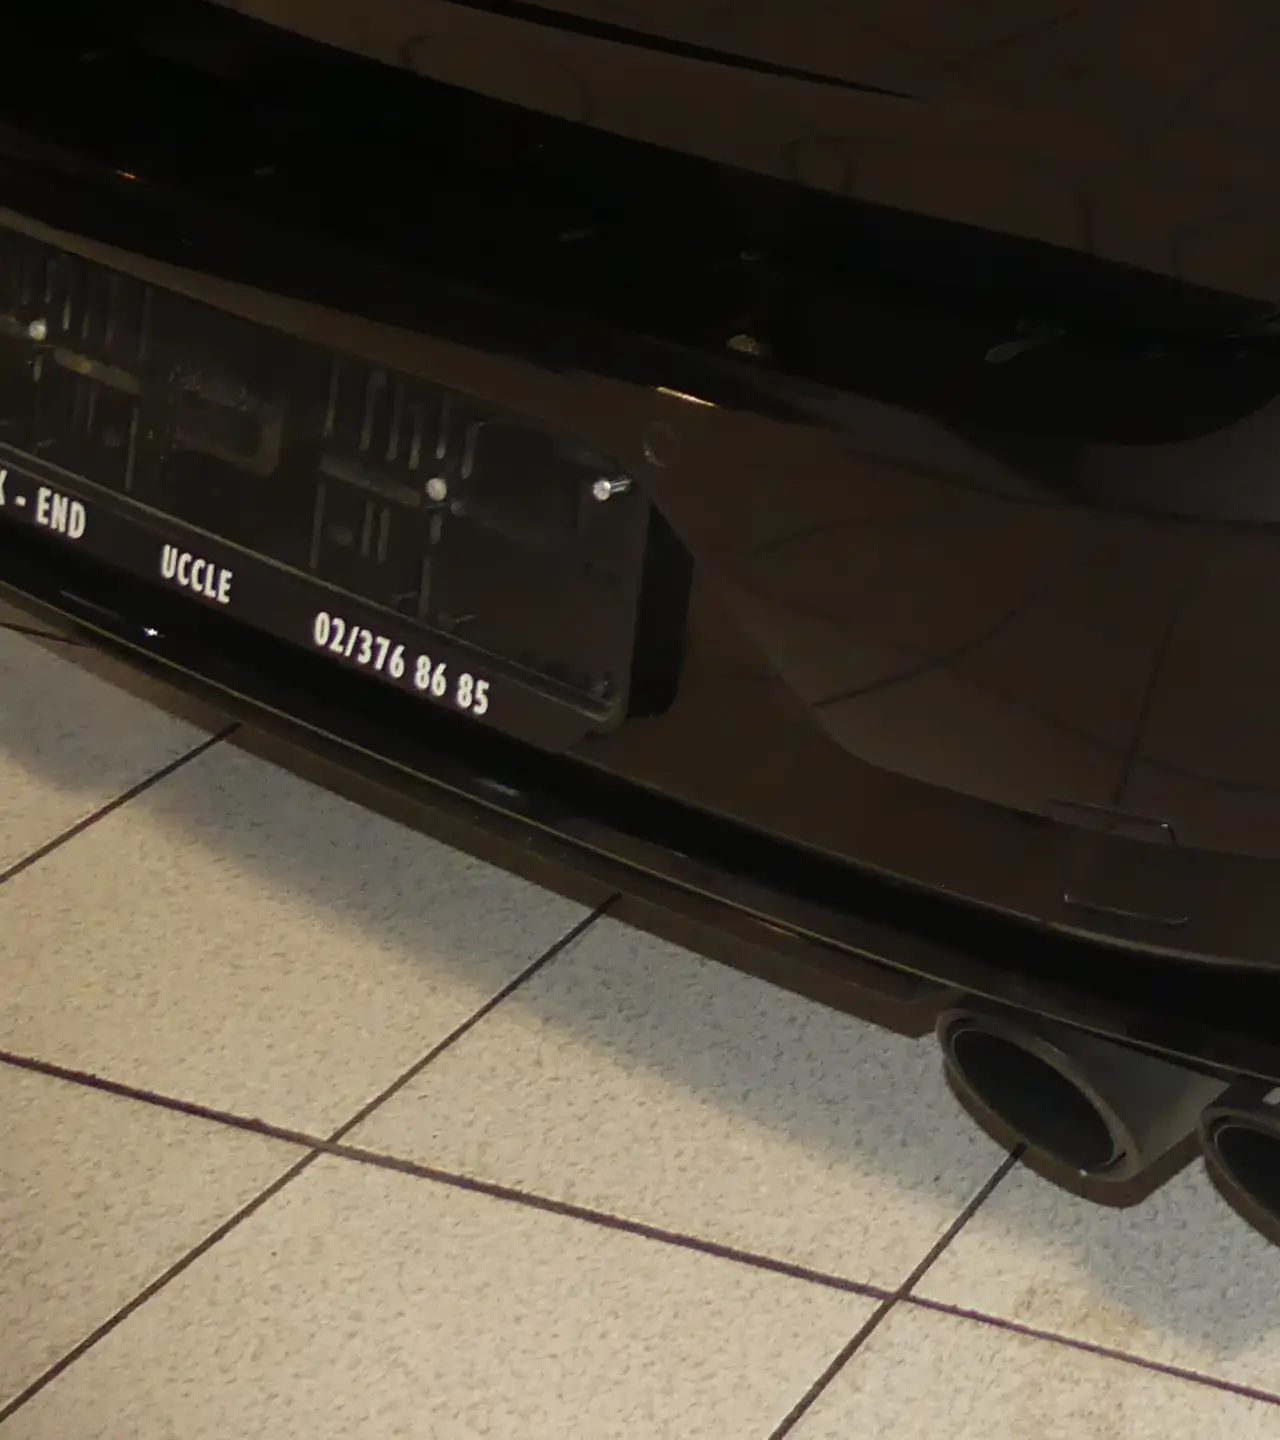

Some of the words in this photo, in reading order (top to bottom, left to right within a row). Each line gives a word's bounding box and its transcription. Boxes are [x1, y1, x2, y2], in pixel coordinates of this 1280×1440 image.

[36, 486, 86, 539] END
[160, 544, 233, 605] UCCLE
[312, 611, 405, 682] 02/376
[415, 654, 447, 699] 86
[457, 672, 490, 716] 85
